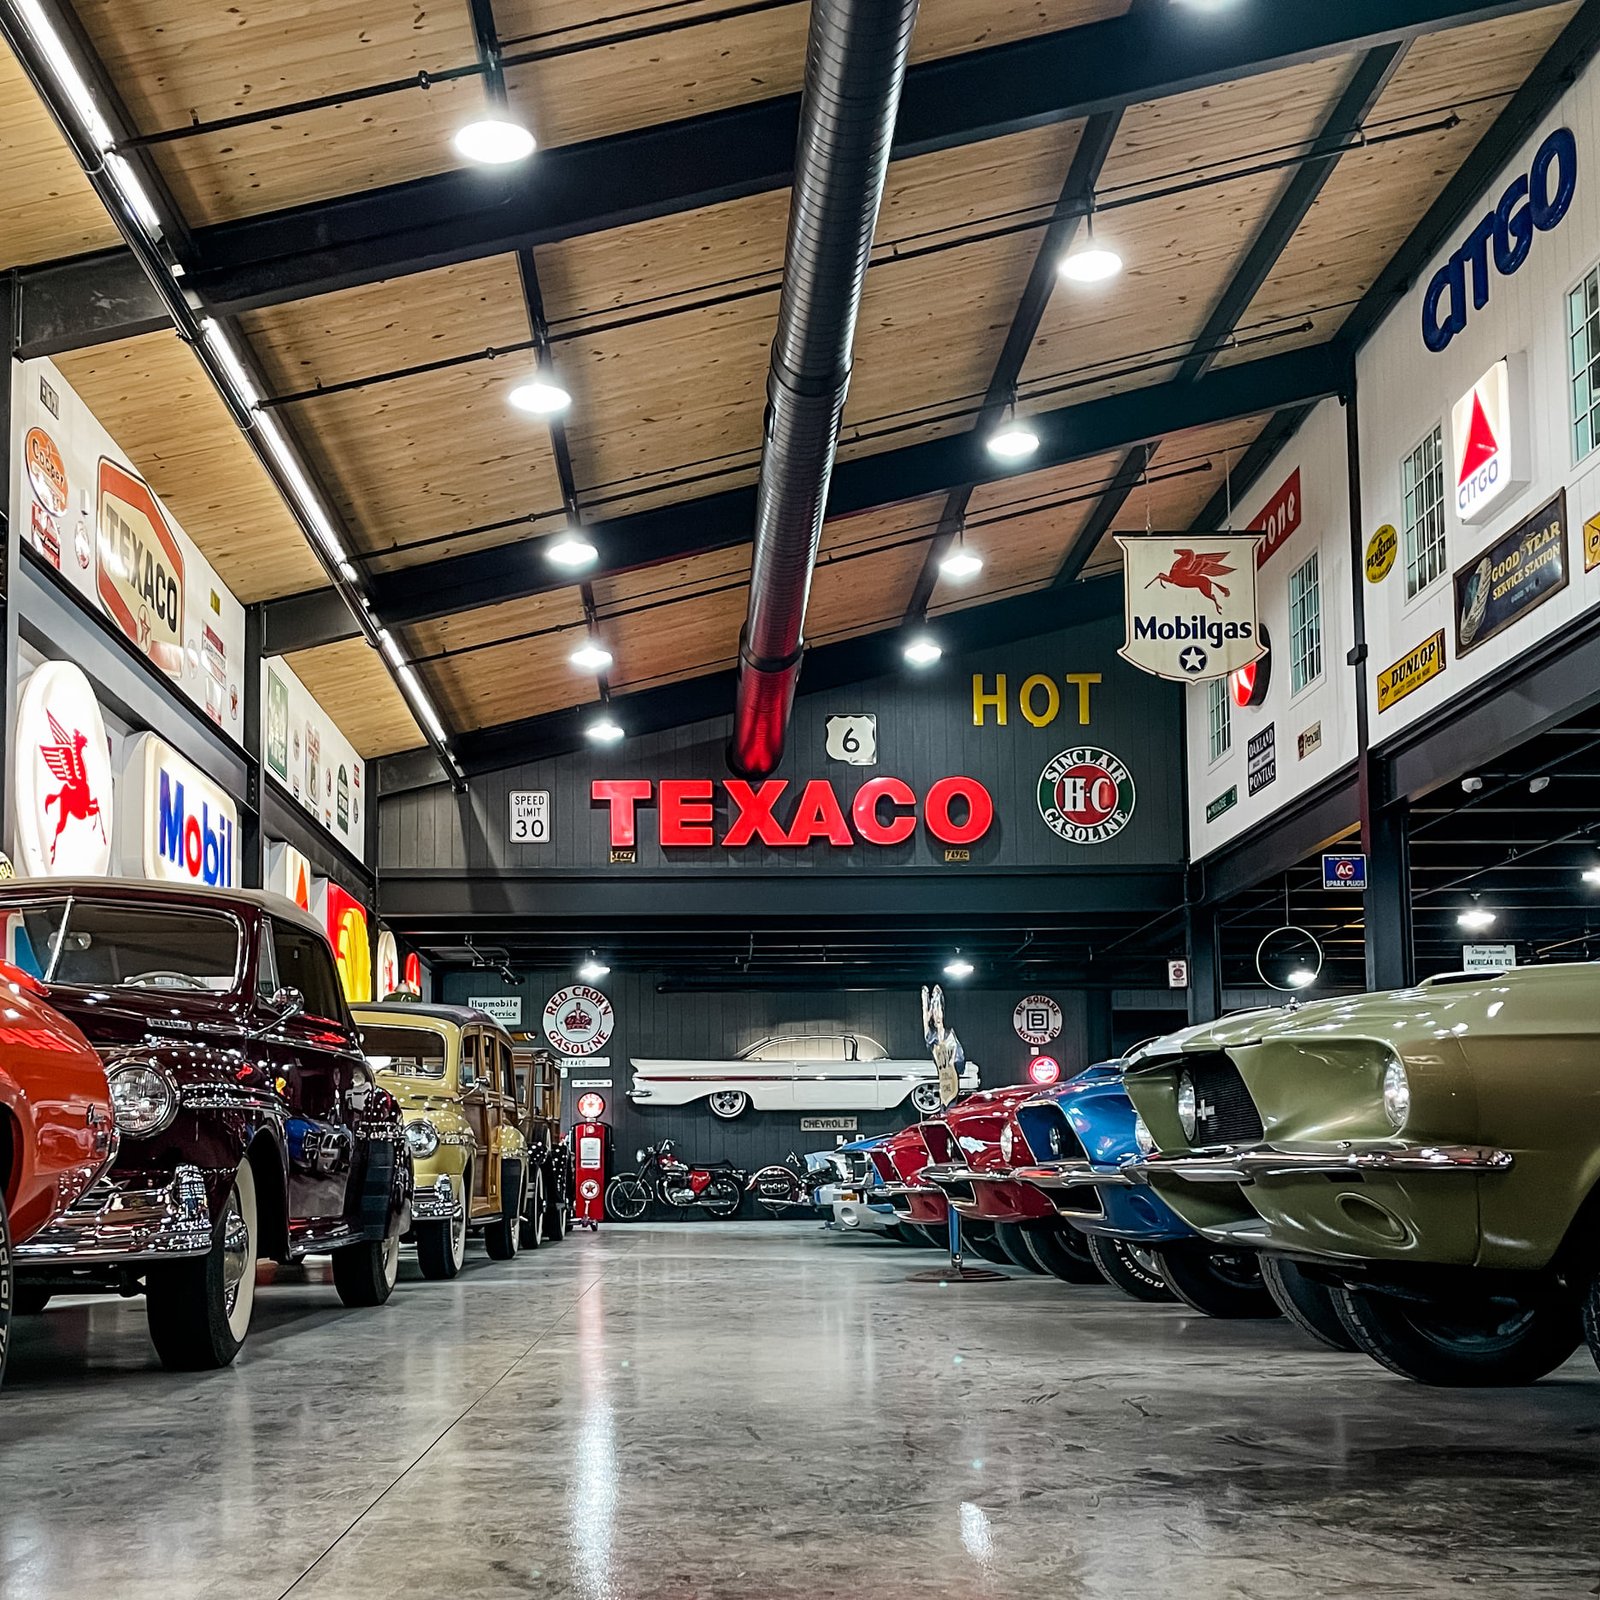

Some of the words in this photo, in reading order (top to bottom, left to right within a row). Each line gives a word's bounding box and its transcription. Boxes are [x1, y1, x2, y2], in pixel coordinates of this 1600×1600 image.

[1421, 127, 1577, 353] CITGO
[1458, 458, 1498, 510] CITGO
[1491, 550, 1520, 583] GOOD
[1525, 521, 1561, 556] YEAR
[105, 502, 178, 634] TEXACO
[1492, 569, 1524, 600] SERVICE
[1524, 542, 1561, 577] STATION
[1133, 615, 1253, 648] Mobilgas
[1390, 641, 1436, 688] DUNLOP
[972, 673, 1102, 727] HOT
[842, 728, 860, 753] 6
[1248, 728, 1274, 758] OAKLAND
[1044, 749, 1127, 785] SINCLAIR
[1249, 762, 1275, 791] PONTIAC
[514, 795, 544, 806] SPEED
[517, 807, 541, 817] LIMIT
[591, 776, 994, 846] TEXACO
[159, 766, 232, 888] Mobil
[515, 820, 544, 838] 30
[1044, 808, 1128, 841] GASOLINE
[1337, 864, 1353, 875] AC
[471, 1000, 518, 1009] Hupmobile
[545, 991, 568, 1016] RED
[571, 986, 612, 1016] CROWN
[1015, 1002, 1026, 1016] BE
[1026, 995, 1060, 1016] SQUARE
[1017, 1025, 1046, 1043] MOTOR
[1048, 1025, 1060, 1040] OIL
[1031, 1013, 1045, 1027] B
[548, 1029, 609, 1054] GASOLINE
[803, 1119, 855, 1128] CHEVROLET
[1120, 1256, 1165, 1288] Radial
